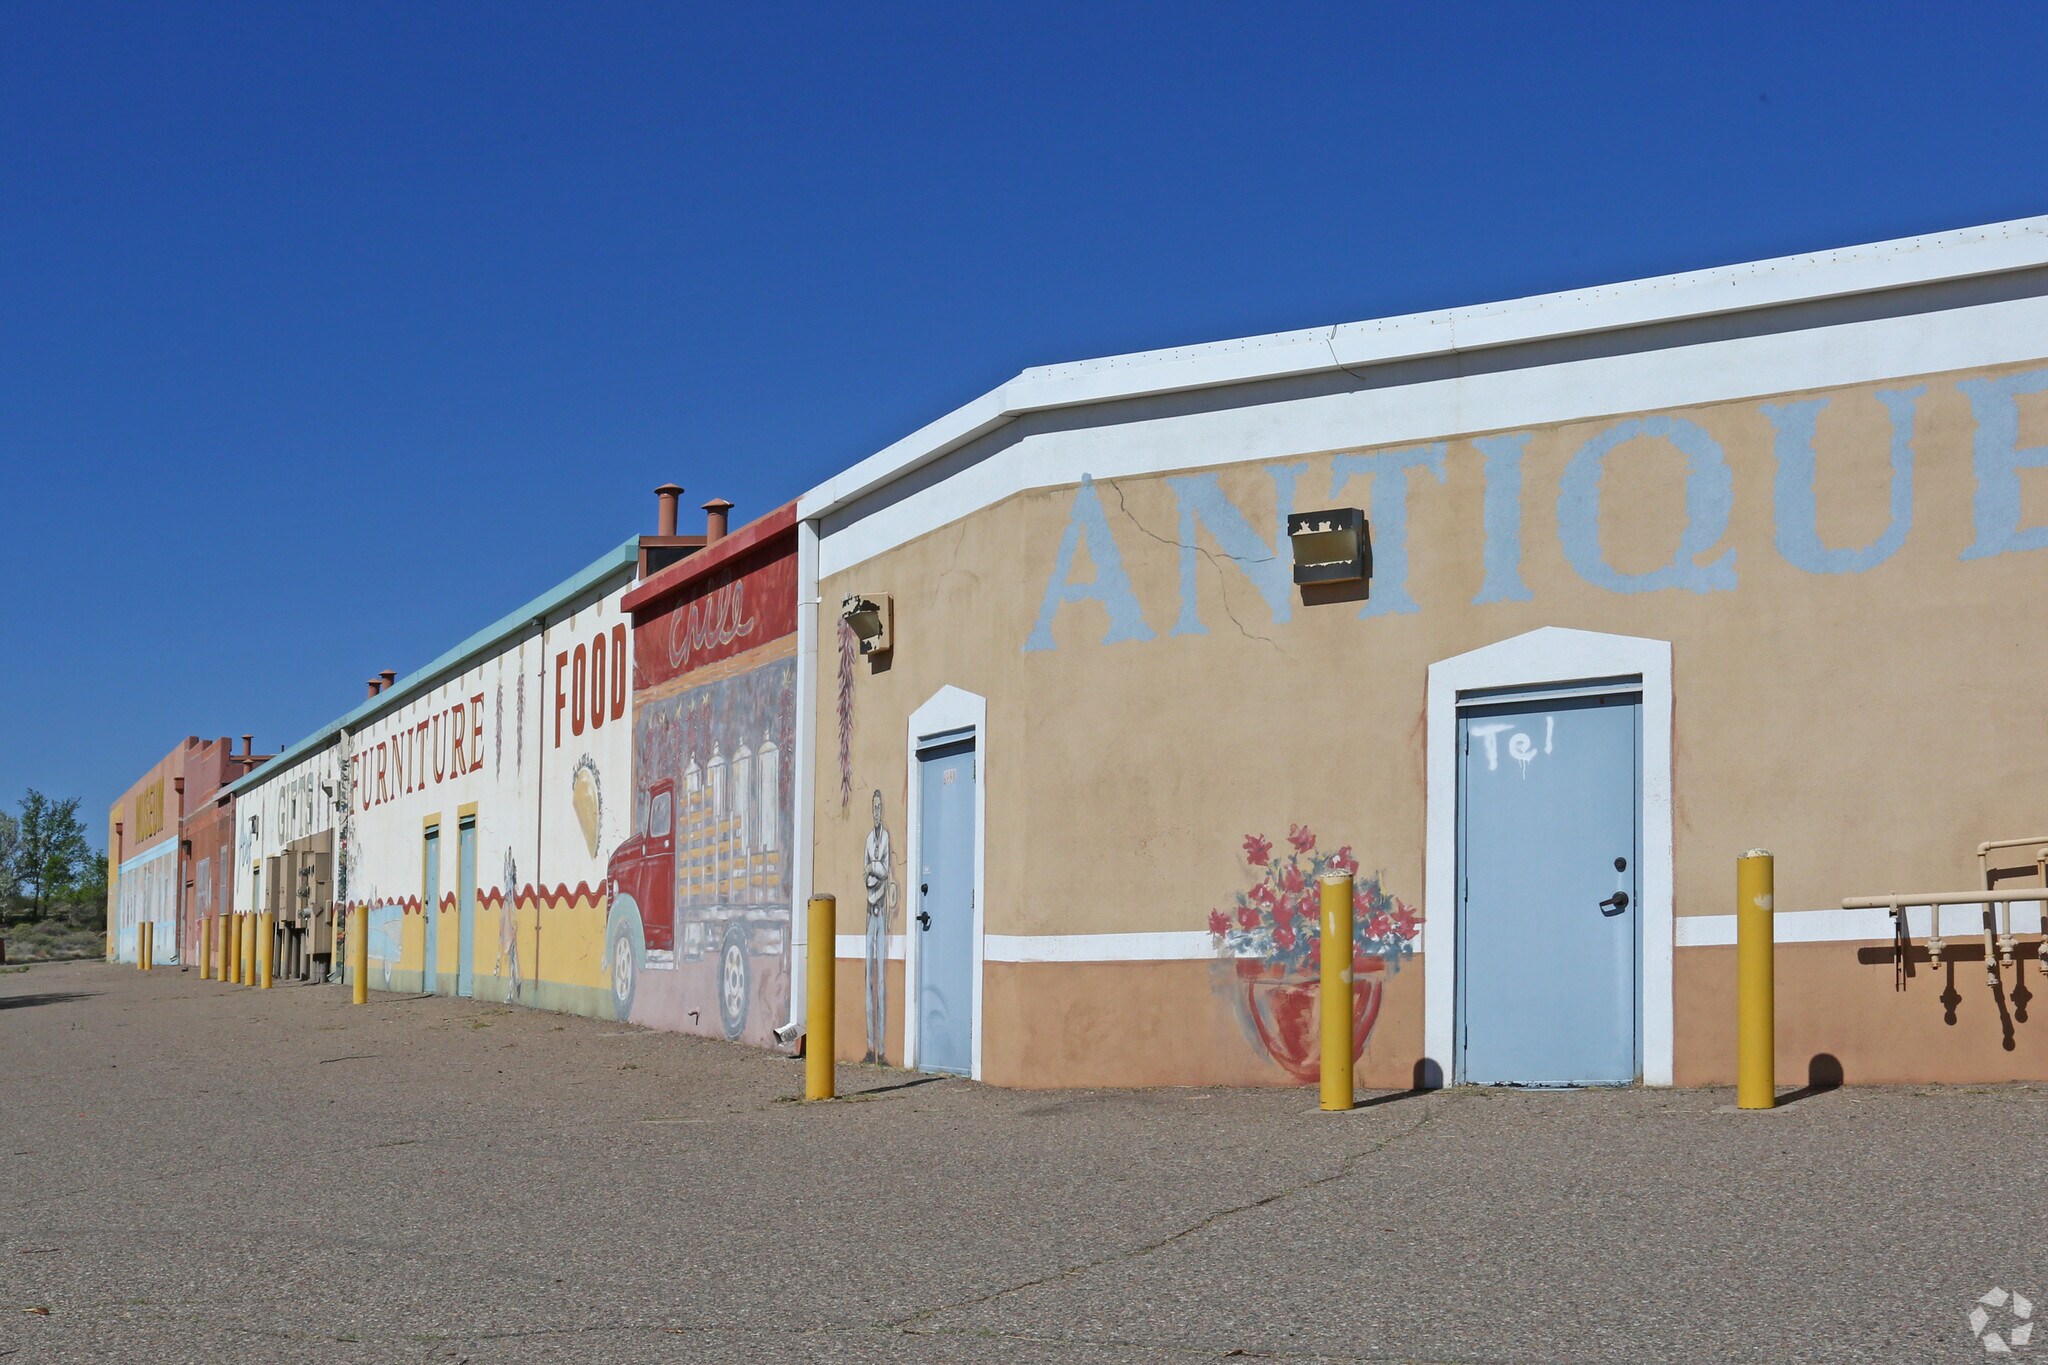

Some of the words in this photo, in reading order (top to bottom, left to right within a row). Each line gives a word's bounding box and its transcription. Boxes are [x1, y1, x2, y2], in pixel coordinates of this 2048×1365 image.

[1022, 368, 2048, 652] ANTIQUE
[555, 622, 627, 749] FOOD
[278, 771, 314, 847] GIFTS
[350, 692, 485, 817] FURNITURE
